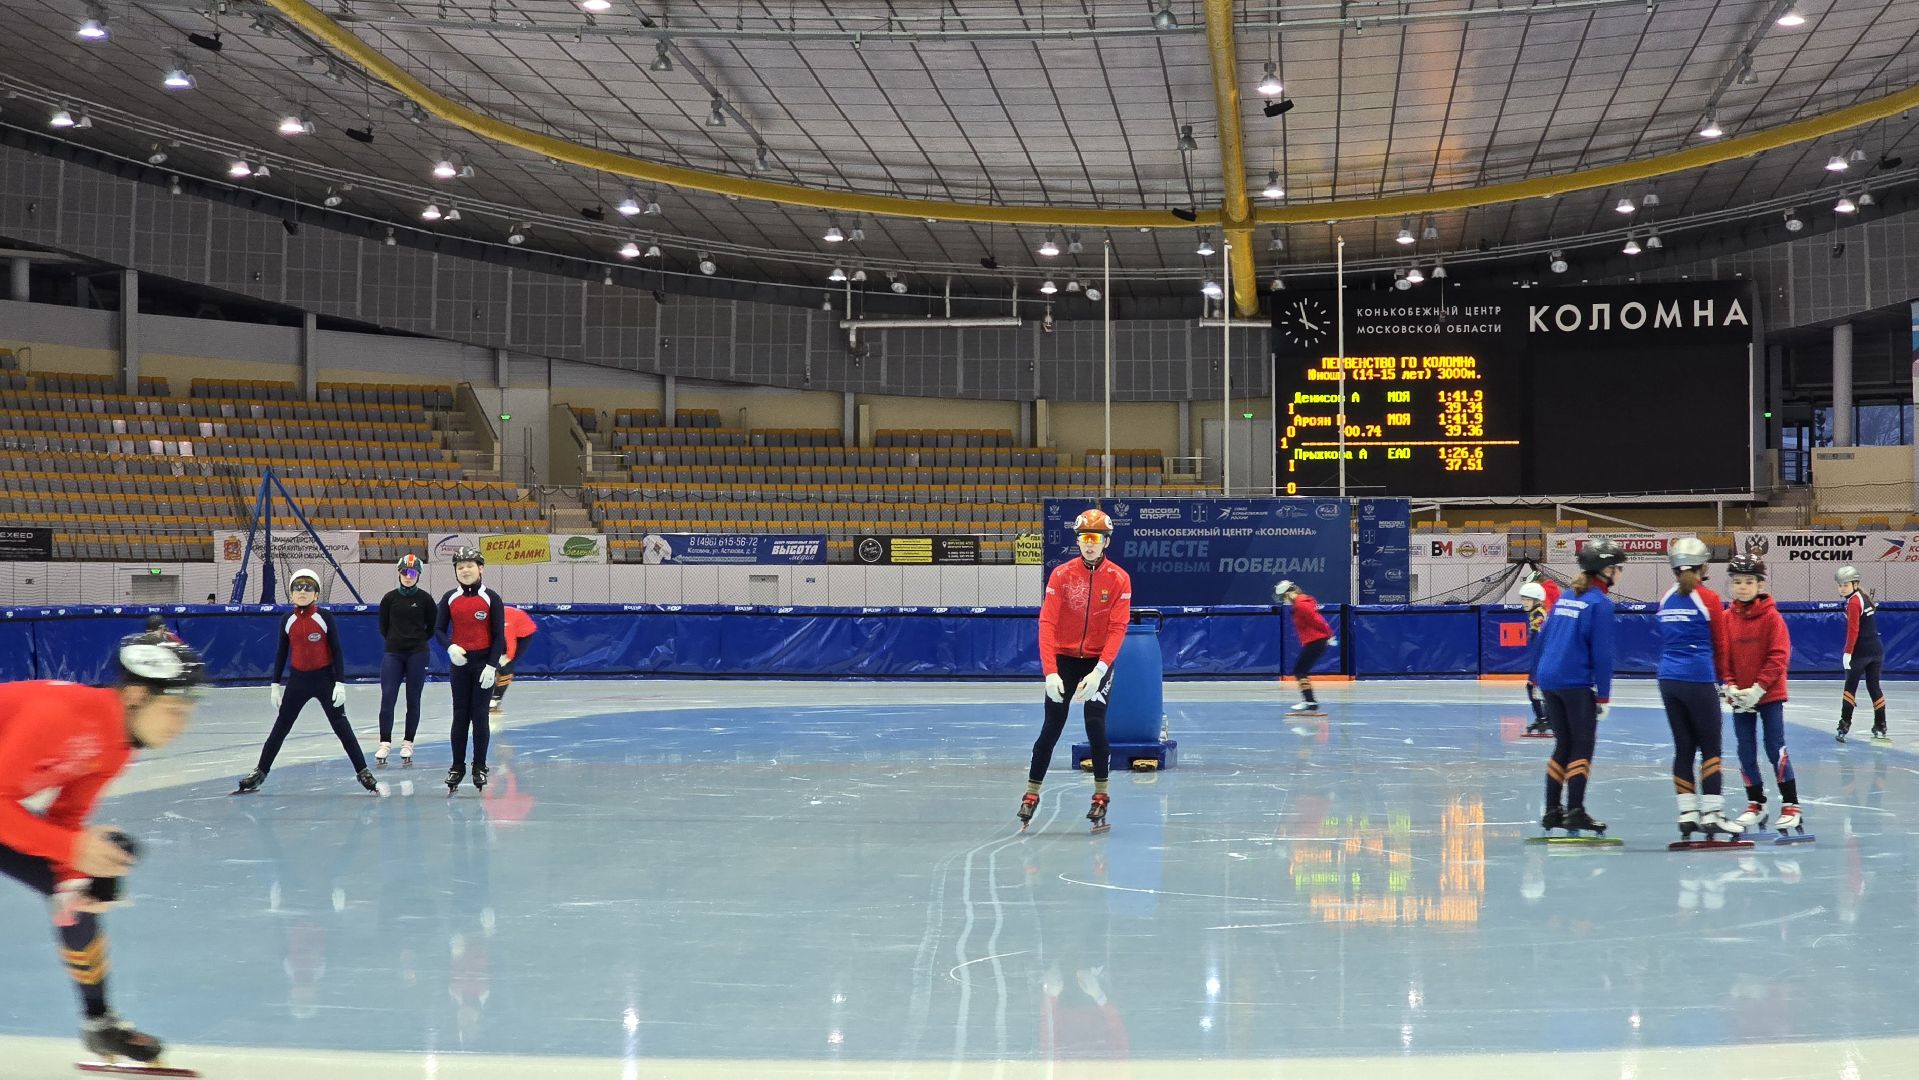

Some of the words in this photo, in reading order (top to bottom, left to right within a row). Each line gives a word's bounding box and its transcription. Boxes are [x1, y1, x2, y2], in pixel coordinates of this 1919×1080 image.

[1465, 306, 1502, 316] ЦЕНТР
[1529, 297, 1749, 334] КОЛОМНА
[1357, 323, 1441, 334] МОСКОВСКОЙ
[1447, 324, 1502, 333] ОБЛАСТИ
[1423, 356, 1475, 368] КОЛОМНА
[1352, 368, 1395, 380] (14-15
[1402, 368, 1431, 379] лет)
[1438, 390, 1483, 402] 1:41.9
[1445, 402, 1483, 413] 39.34
[1439, 412, 1483, 425] 1:41.9
[1444, 424, 1483, 436] 39.36
[1439, 447, 1483, 459] 1:26.6
[1444, 458, 1483, 470] 37.51
[1133, 527, 1221, 537] КОНЬКОБЕЖНЫЙ
[1222, 528, 1253, 537] ЦЕНТР
[1255, 527, 1317, 537] «КОЛОМНА»
[486, 539, 521, 551] ВСЕГДА
[689, 537, 696, 547] 8
[719, 537, 758, 547] 615-56-72
[1776, 535, 1867, 547] МИНСПОРТ
[513, 549, 545, 560] ВАМИ!
[772, 545, 818, 555] ВЫСОТА
[1123, 540, 1209, 558] ВМЕСТЕ
[1789, 550, 1853, 561] РОССИИ
[1137, 561, 1148, 573] К
[1151, 561, 1210, 573] НОВЫМ
[1218, 558, 1326, 575] ПОБЕДАМ!
